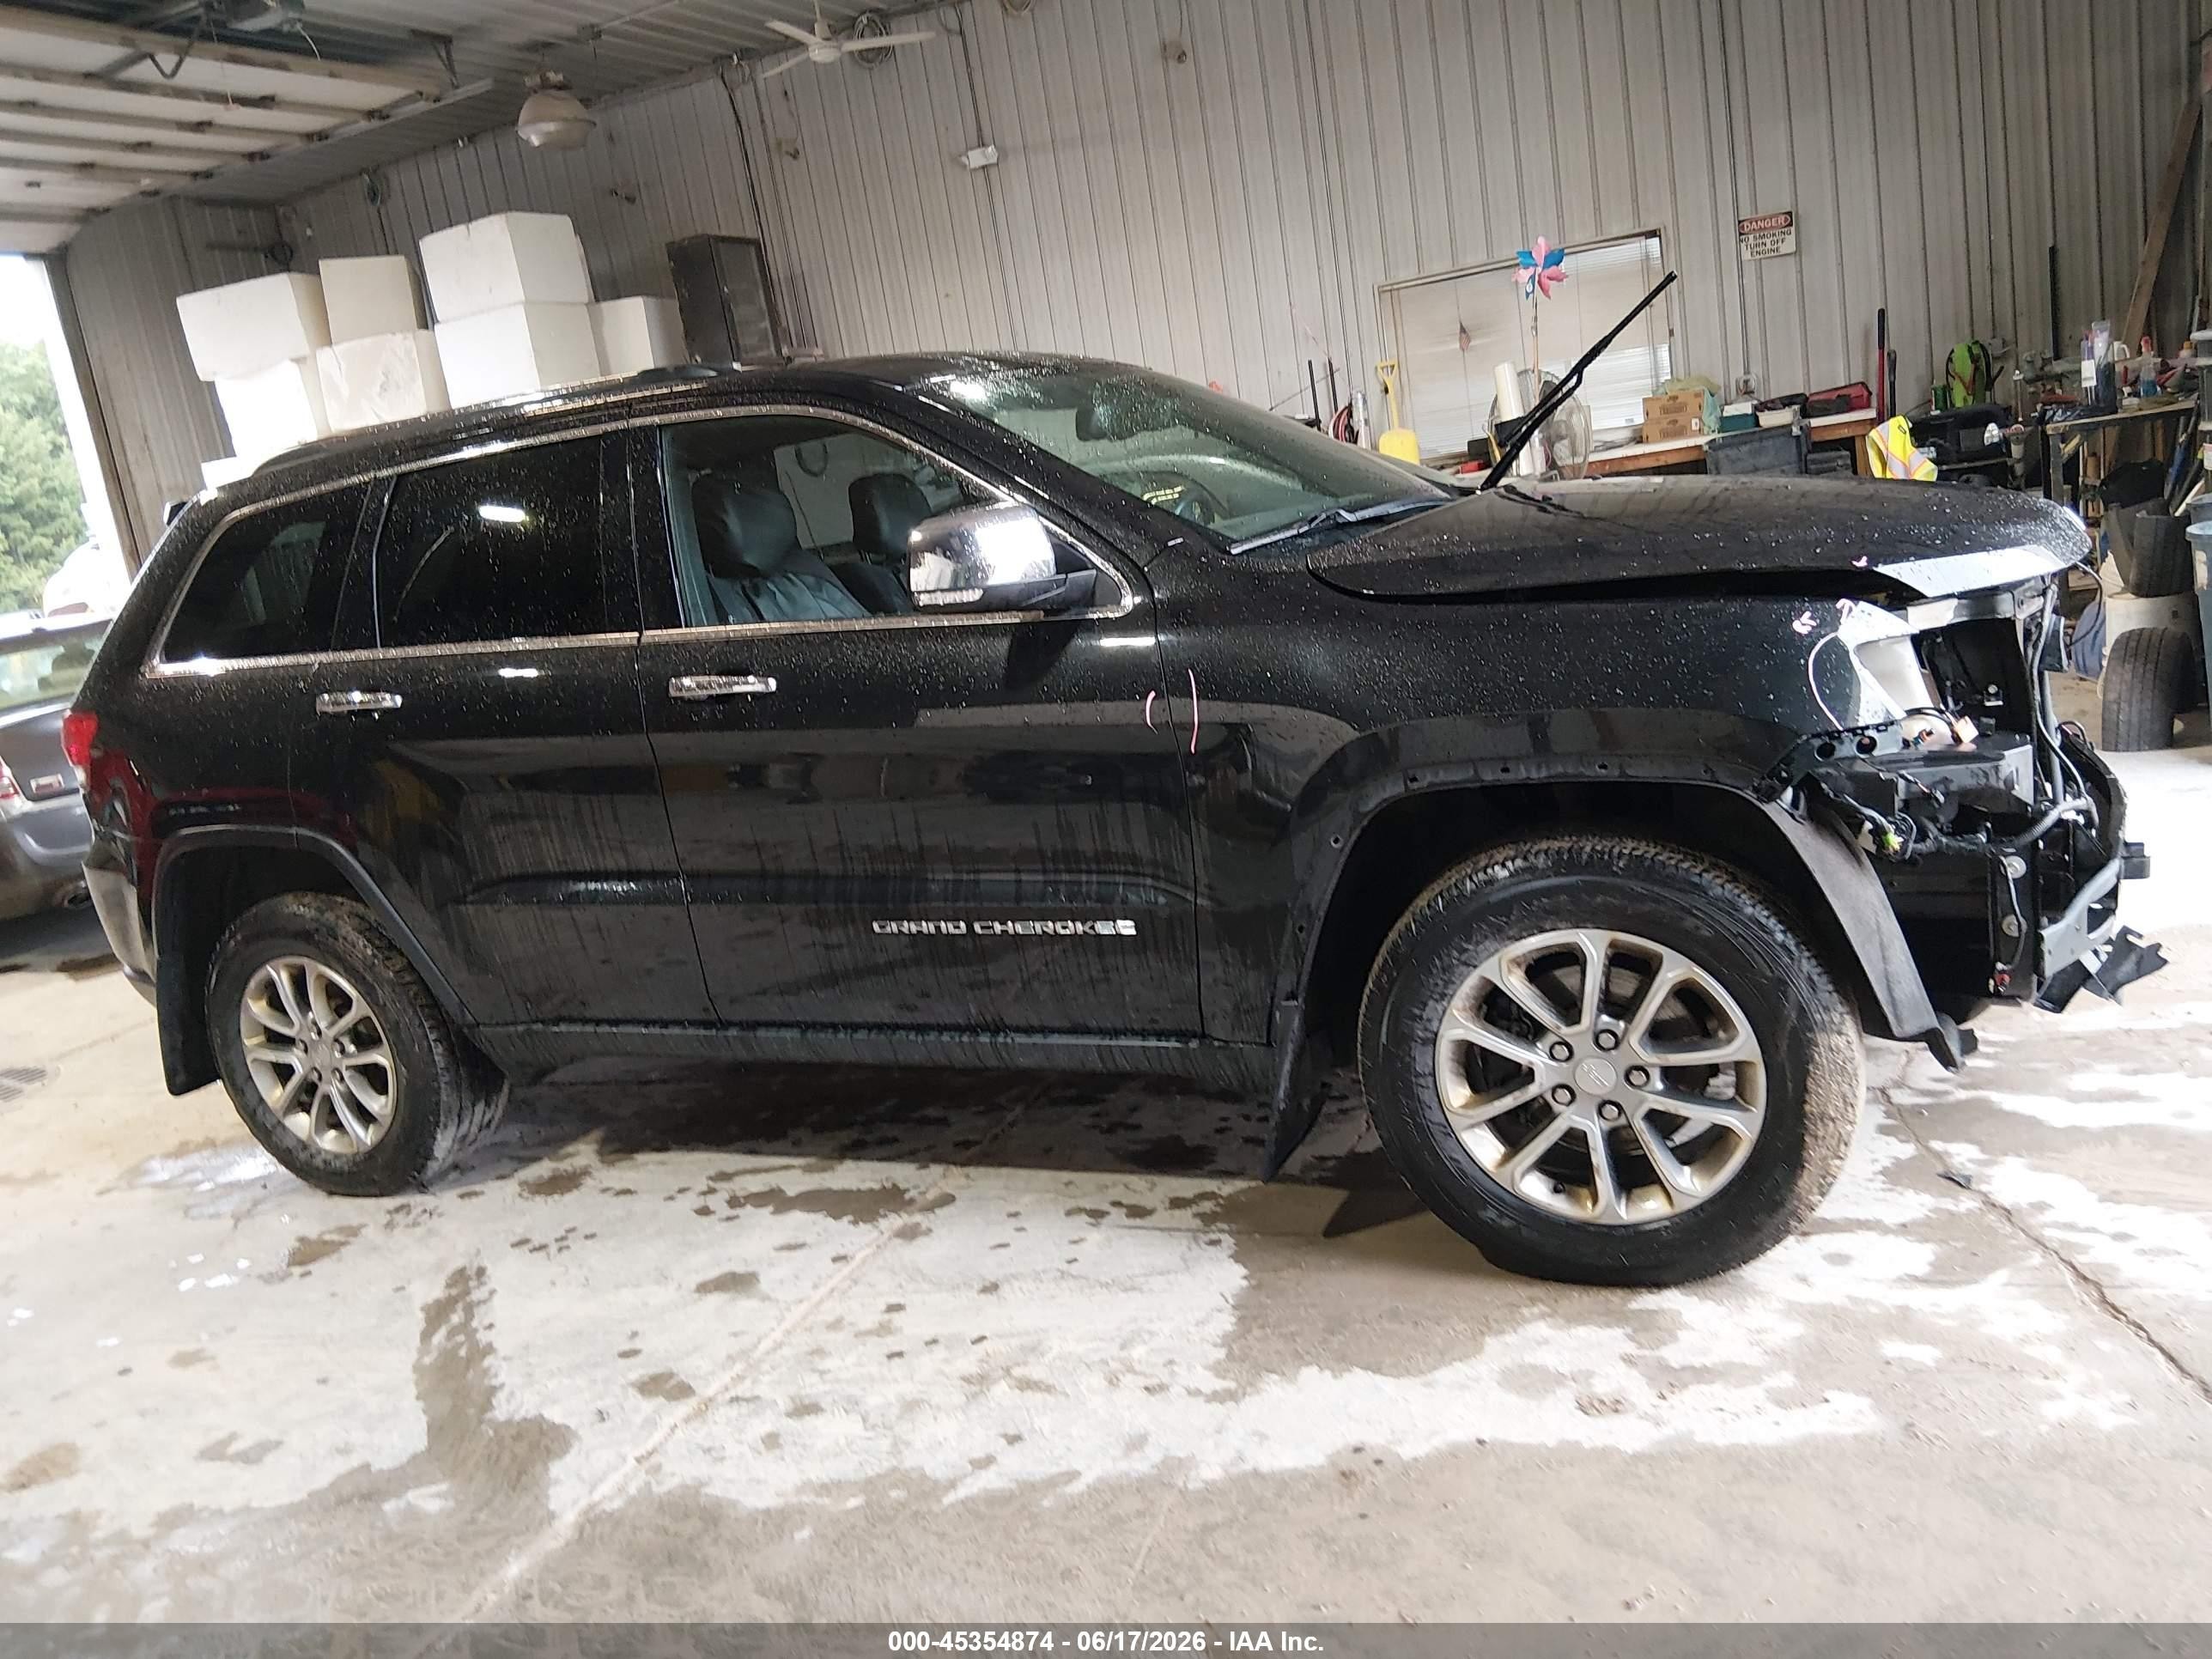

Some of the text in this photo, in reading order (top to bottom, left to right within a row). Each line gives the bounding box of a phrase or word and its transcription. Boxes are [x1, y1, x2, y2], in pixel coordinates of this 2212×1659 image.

[1744, 216, 1785, 232] DANGER
[1753, 229, 1791, 241] SMOKING
[1745, 238, 1786, 251] TURN OFF
[1750, 246, 1781, 258] ENGINE
[872, 920, 1138, 936] GRAND CHEROKEE
